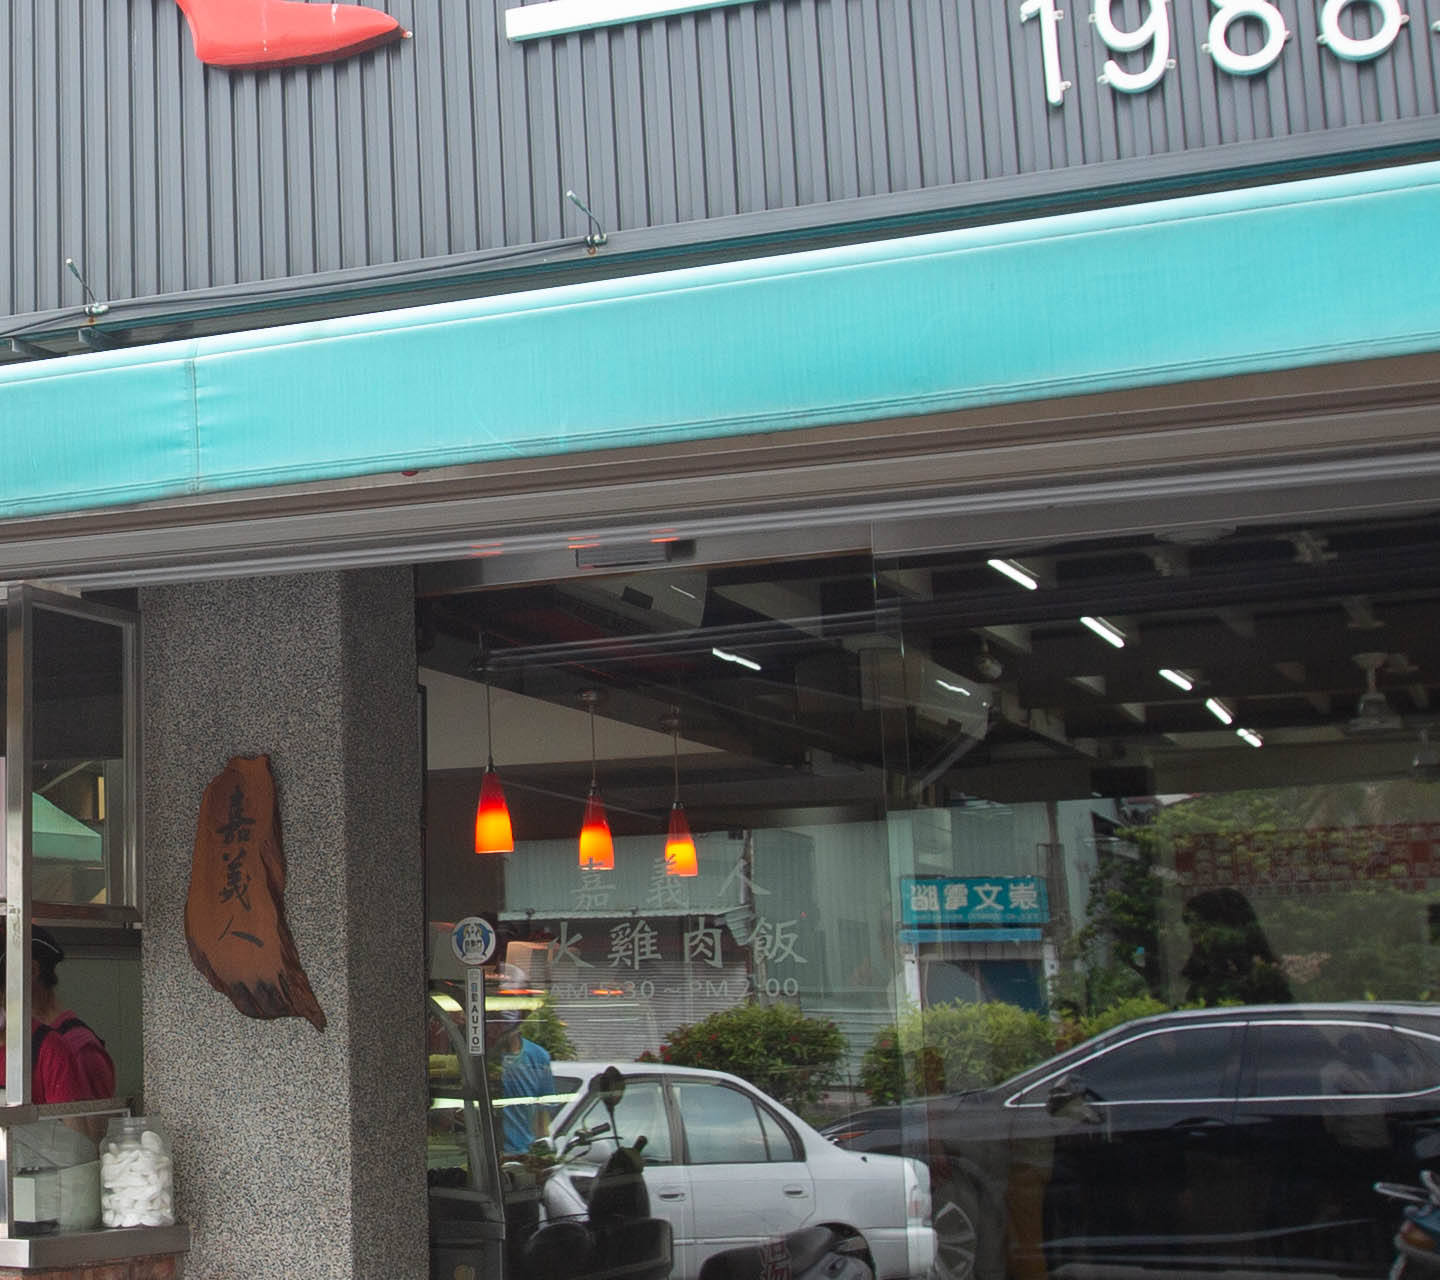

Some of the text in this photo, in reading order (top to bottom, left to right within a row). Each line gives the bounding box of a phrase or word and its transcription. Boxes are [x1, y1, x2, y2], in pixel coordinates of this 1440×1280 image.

[216, 784, 265, 949] 嘉義人
[548, 916, 808, 970] 火雞肉飯
